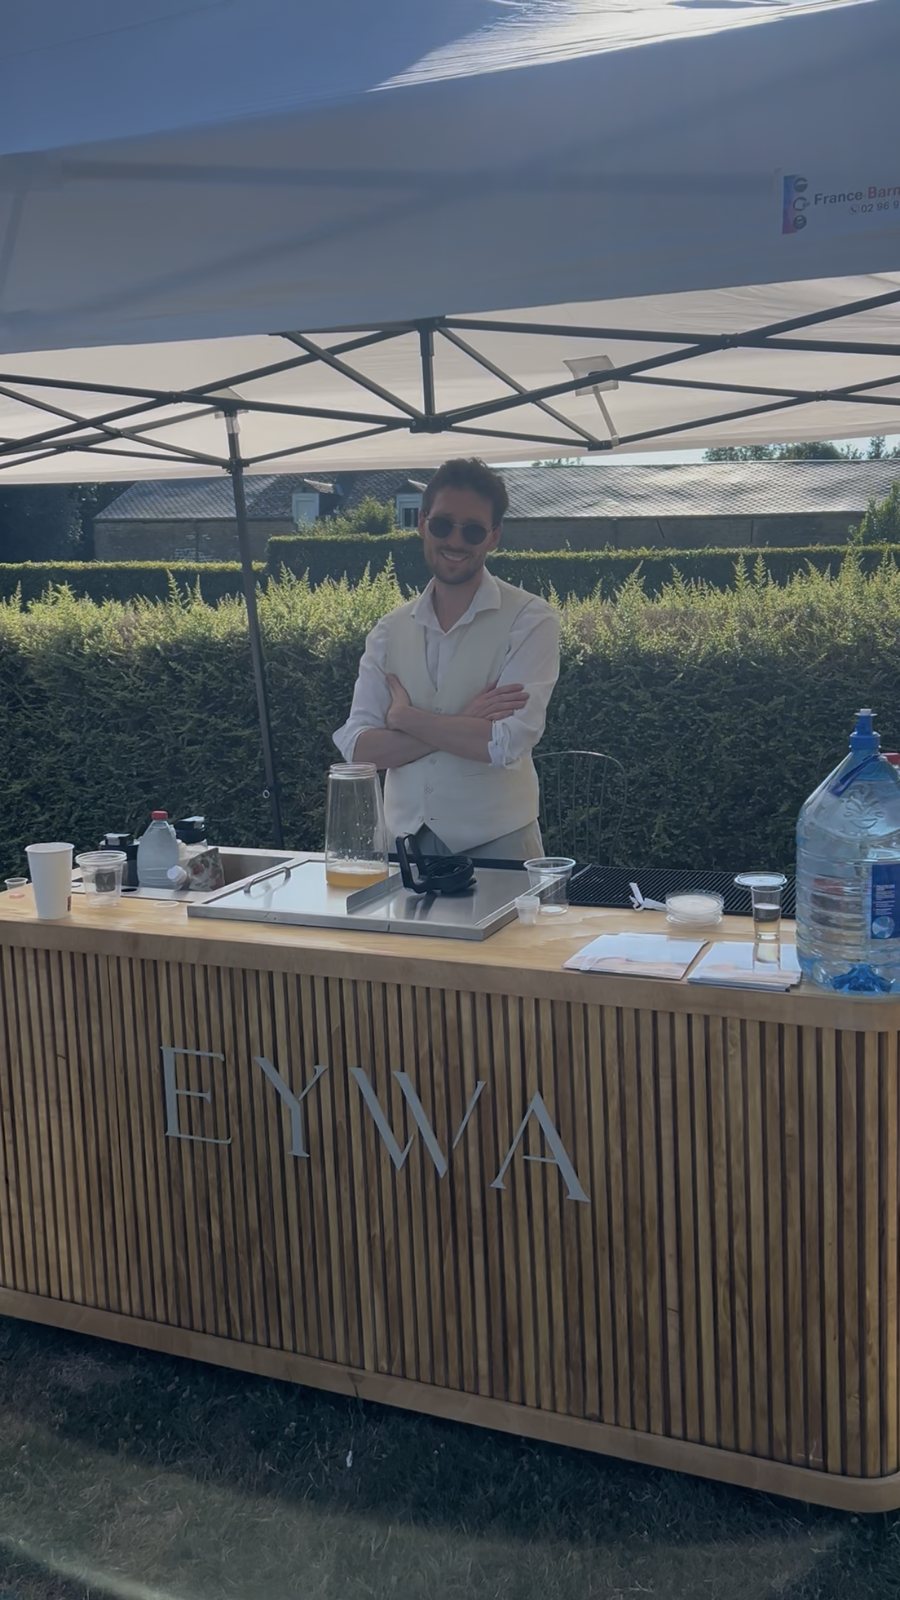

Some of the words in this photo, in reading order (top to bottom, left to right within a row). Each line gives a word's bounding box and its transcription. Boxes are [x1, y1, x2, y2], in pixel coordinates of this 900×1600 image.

[814, 191, 863, 205] France
[861, 203, 874, 213] 02
[160, 1046, 590, 1202] EYWA
